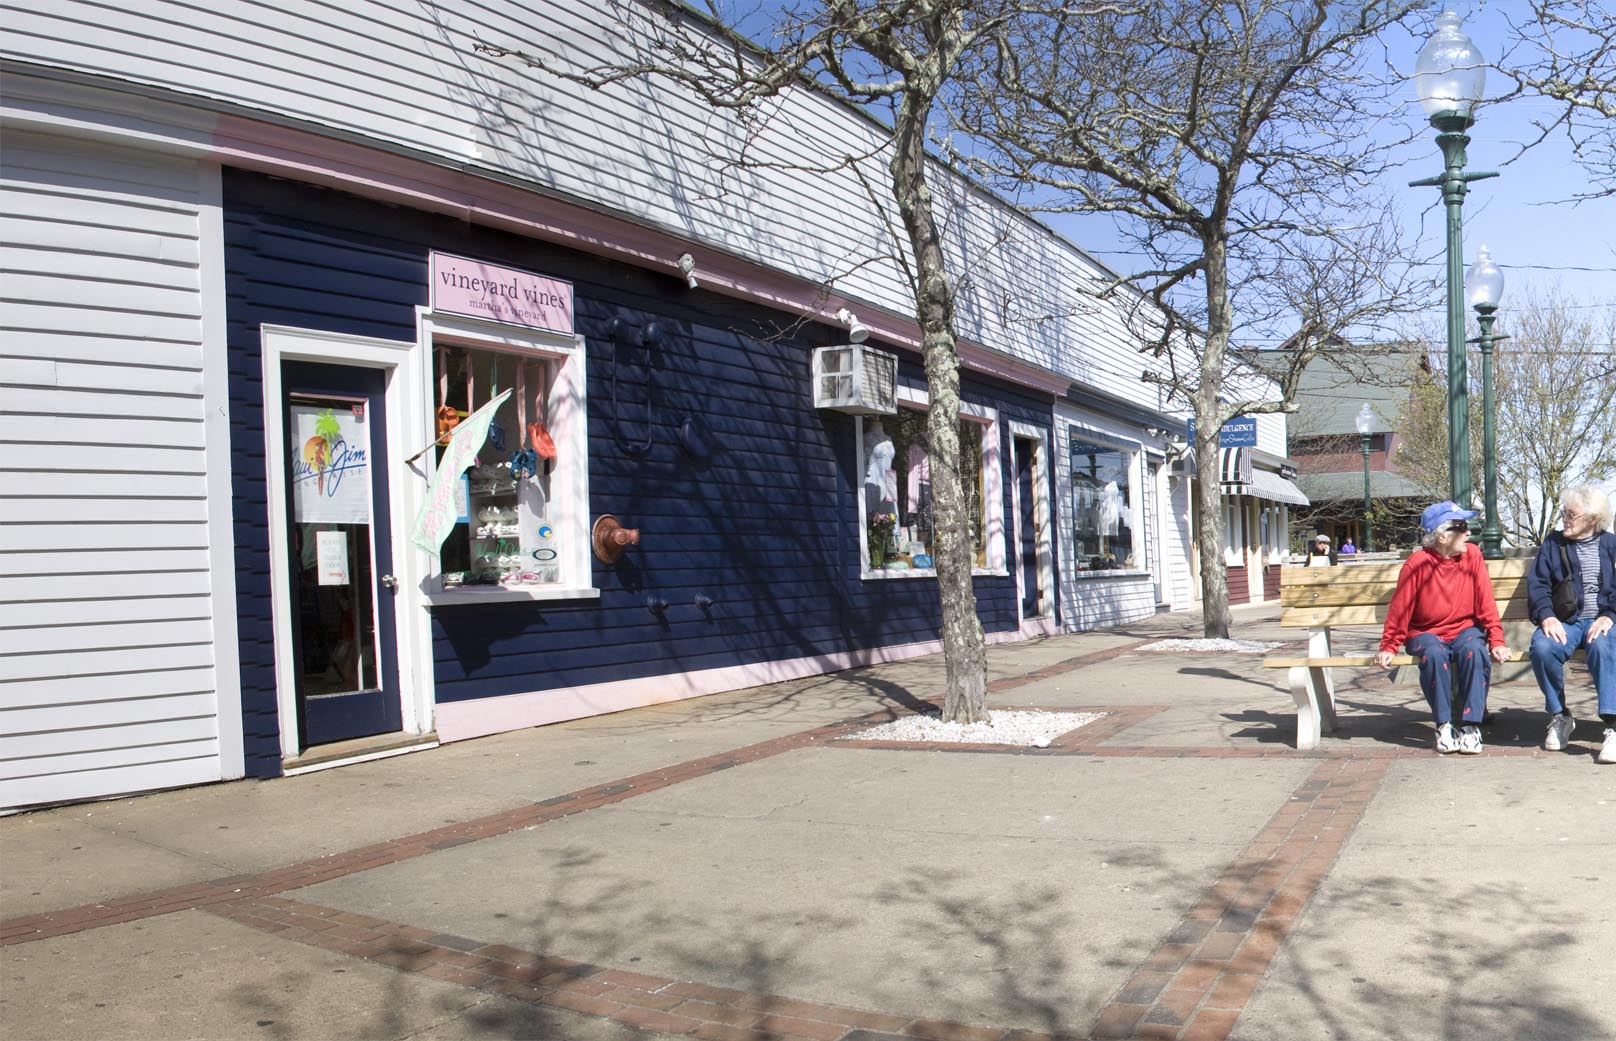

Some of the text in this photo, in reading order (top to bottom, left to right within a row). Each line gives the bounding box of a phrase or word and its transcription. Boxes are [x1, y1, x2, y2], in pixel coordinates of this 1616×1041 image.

[441, 267, 566, 310] vineyard vines
[469, 299, 546, 323] martha's vineyard
[1220, 423, 1254, 433] NDULGENCE
[328, 440, 367, 498] Jim
